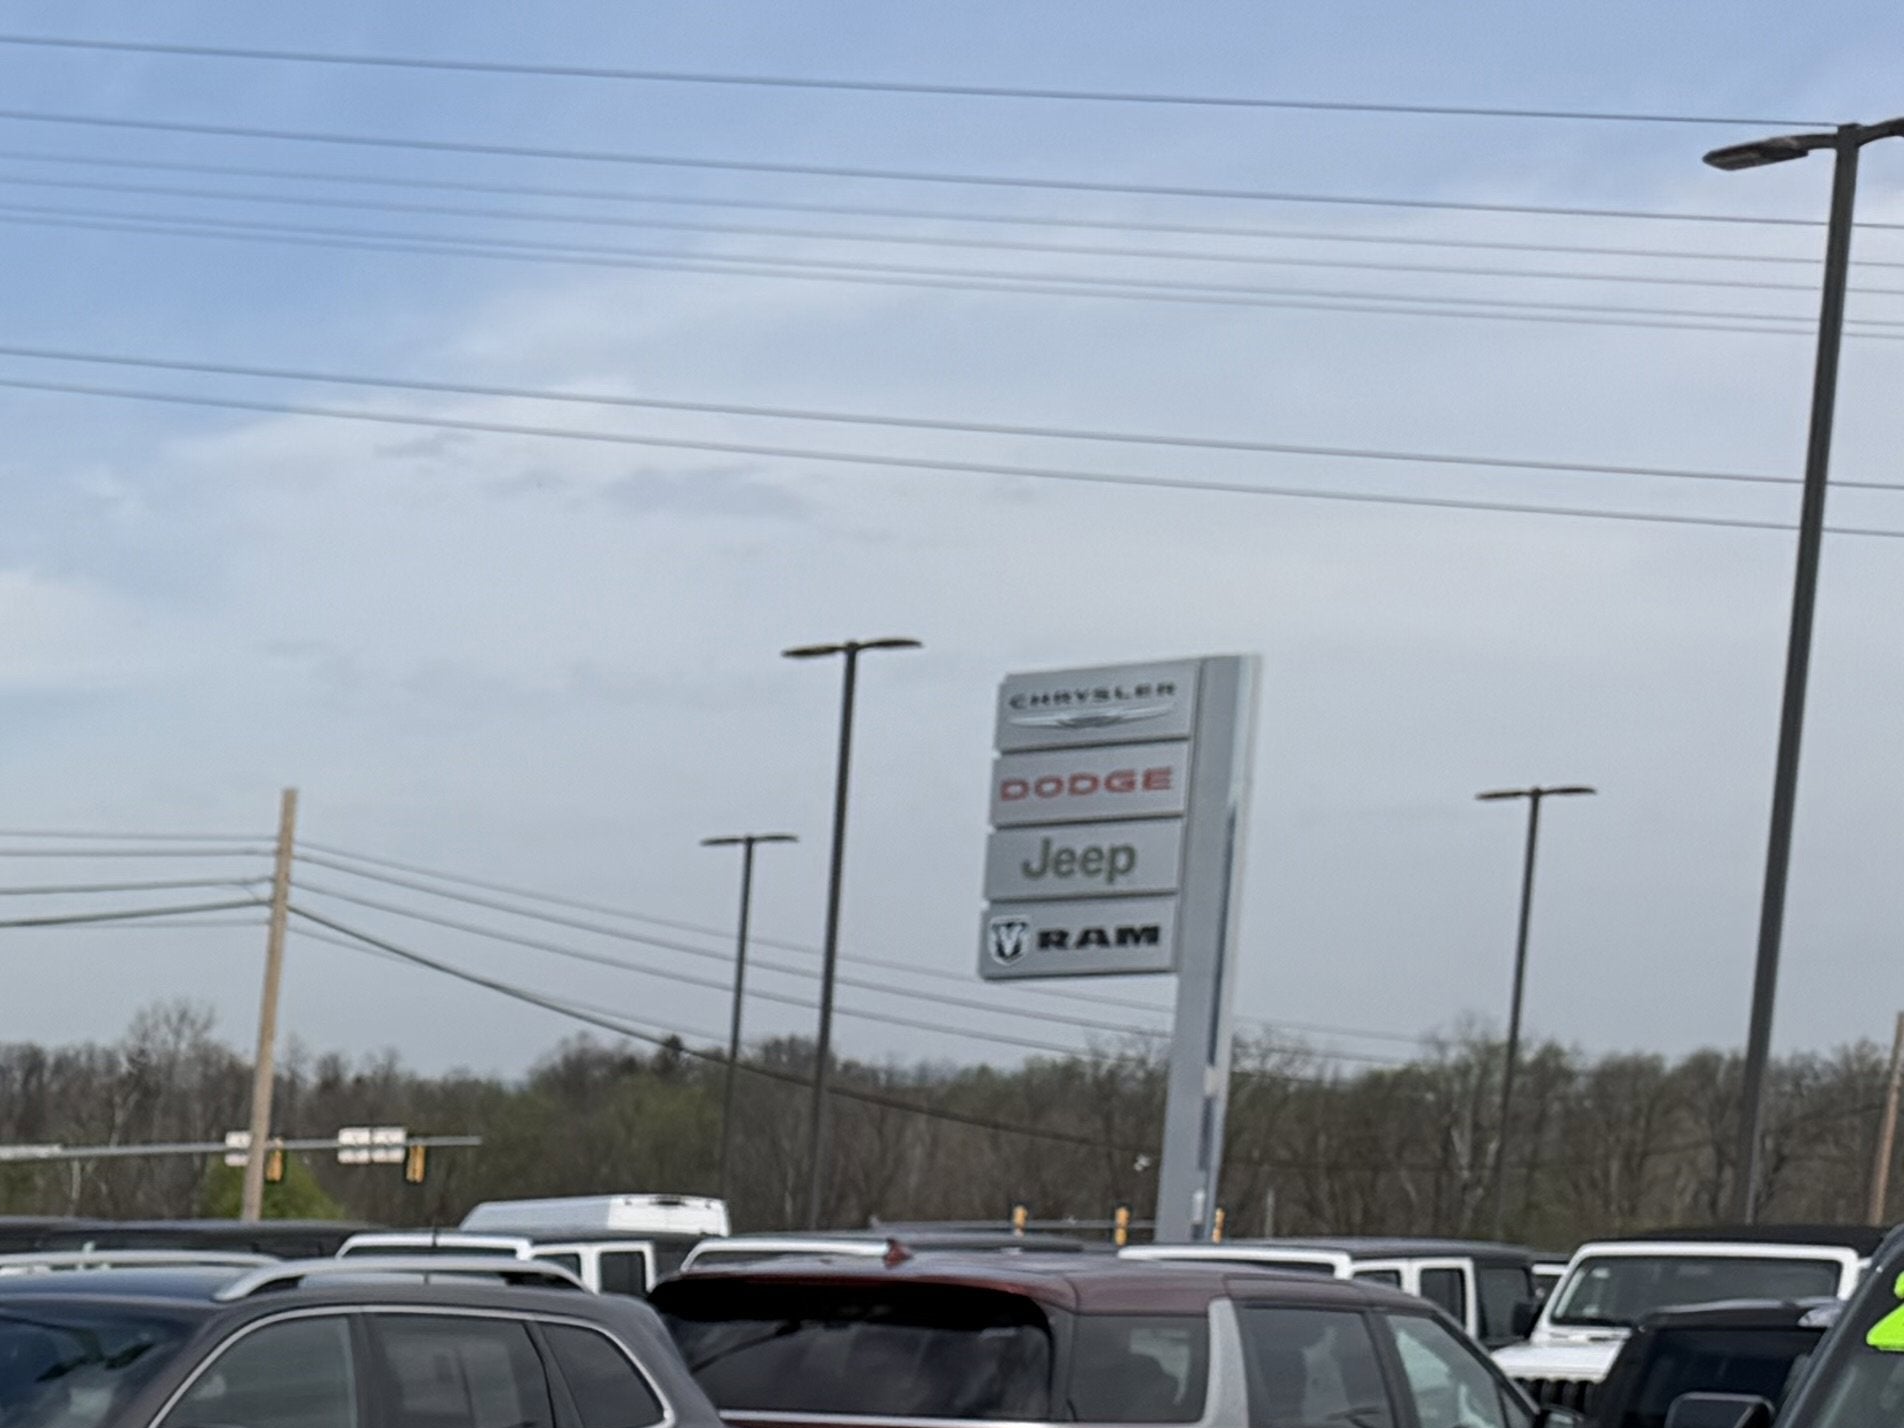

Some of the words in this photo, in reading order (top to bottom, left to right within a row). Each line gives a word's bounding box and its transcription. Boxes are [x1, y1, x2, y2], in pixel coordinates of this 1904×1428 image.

[1009, 682, 1176, 709] CHRYSLER
[999, 767, 1173, 801] DODGE
[1021, 837, 1136, 884] Jeep
[1037, 924, 1160, 950] RAM
